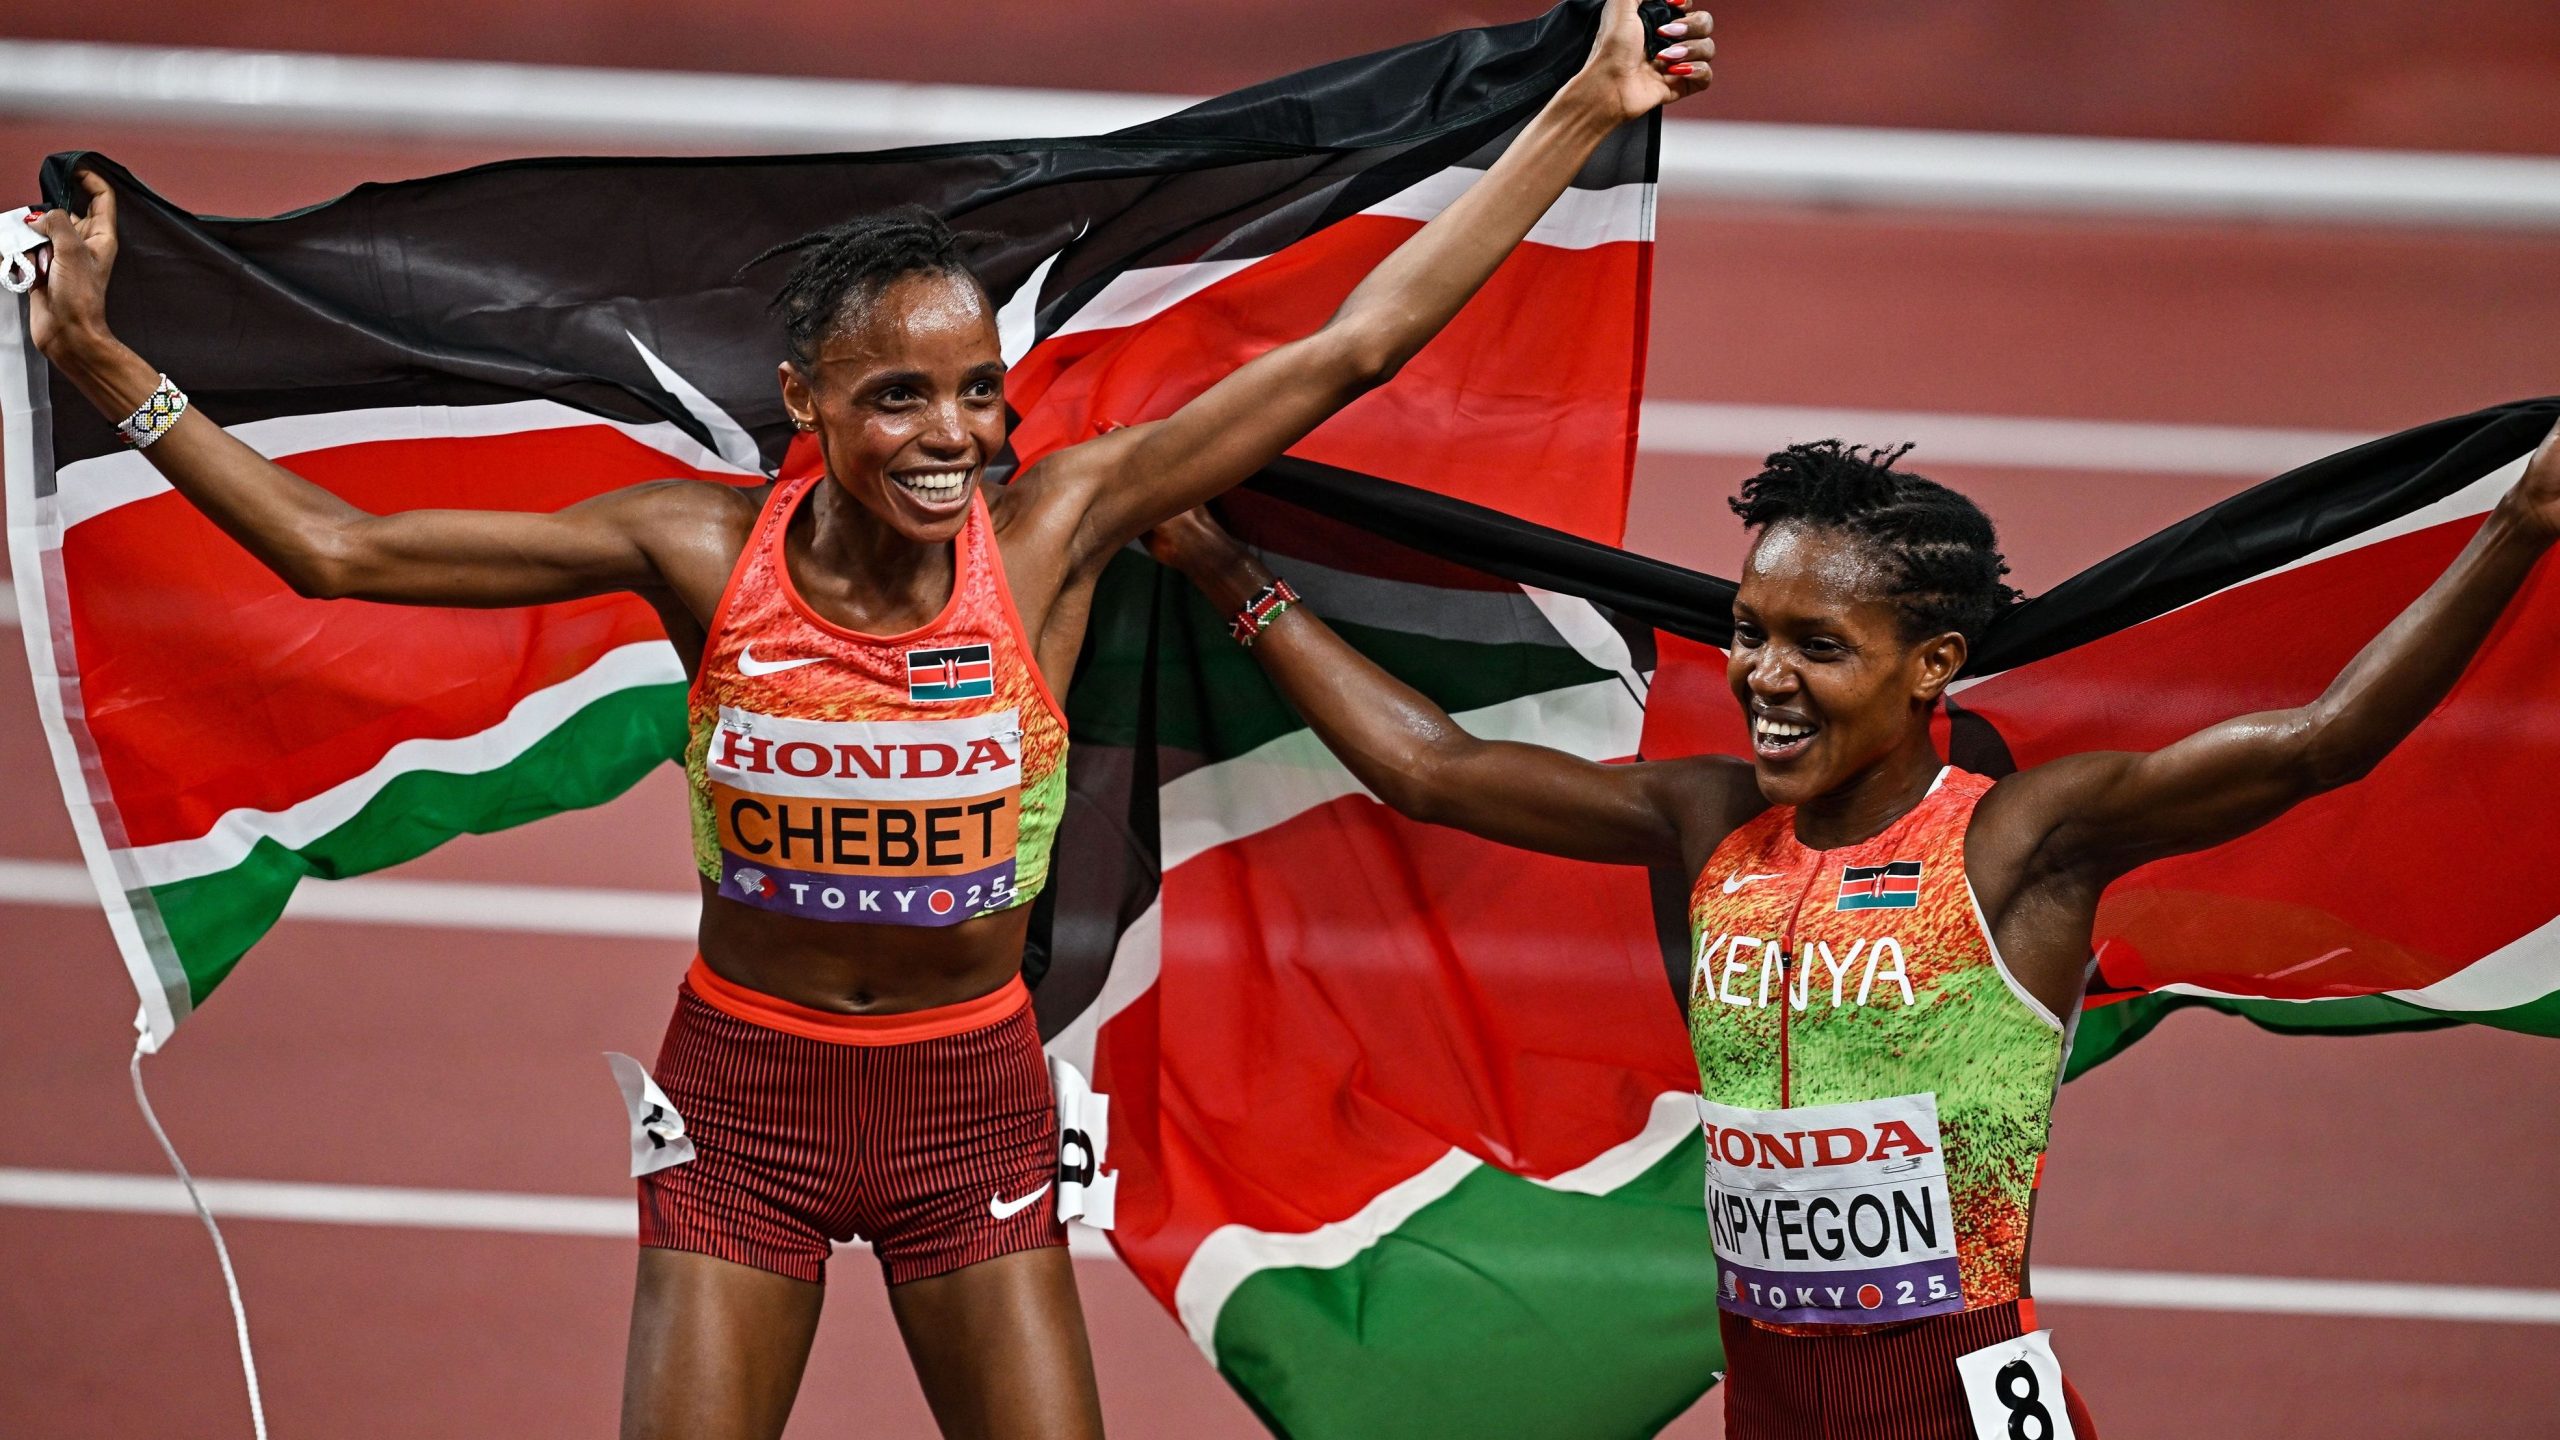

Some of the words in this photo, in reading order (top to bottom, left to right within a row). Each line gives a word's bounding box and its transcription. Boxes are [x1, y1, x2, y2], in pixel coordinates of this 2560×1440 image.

[715, 729, 1015, 779] HONDA
[730, 797, 1006, 866] CHEBET
[965, 875, 1007, 907] 25
[1691, 930, 1915, 1011] KENYA
[1708, 1186, 1937, 1261] KIPYEGON
[1896, 1274, 1947, 1305] 25
[1995, 1359, 2054, 1440] 8
